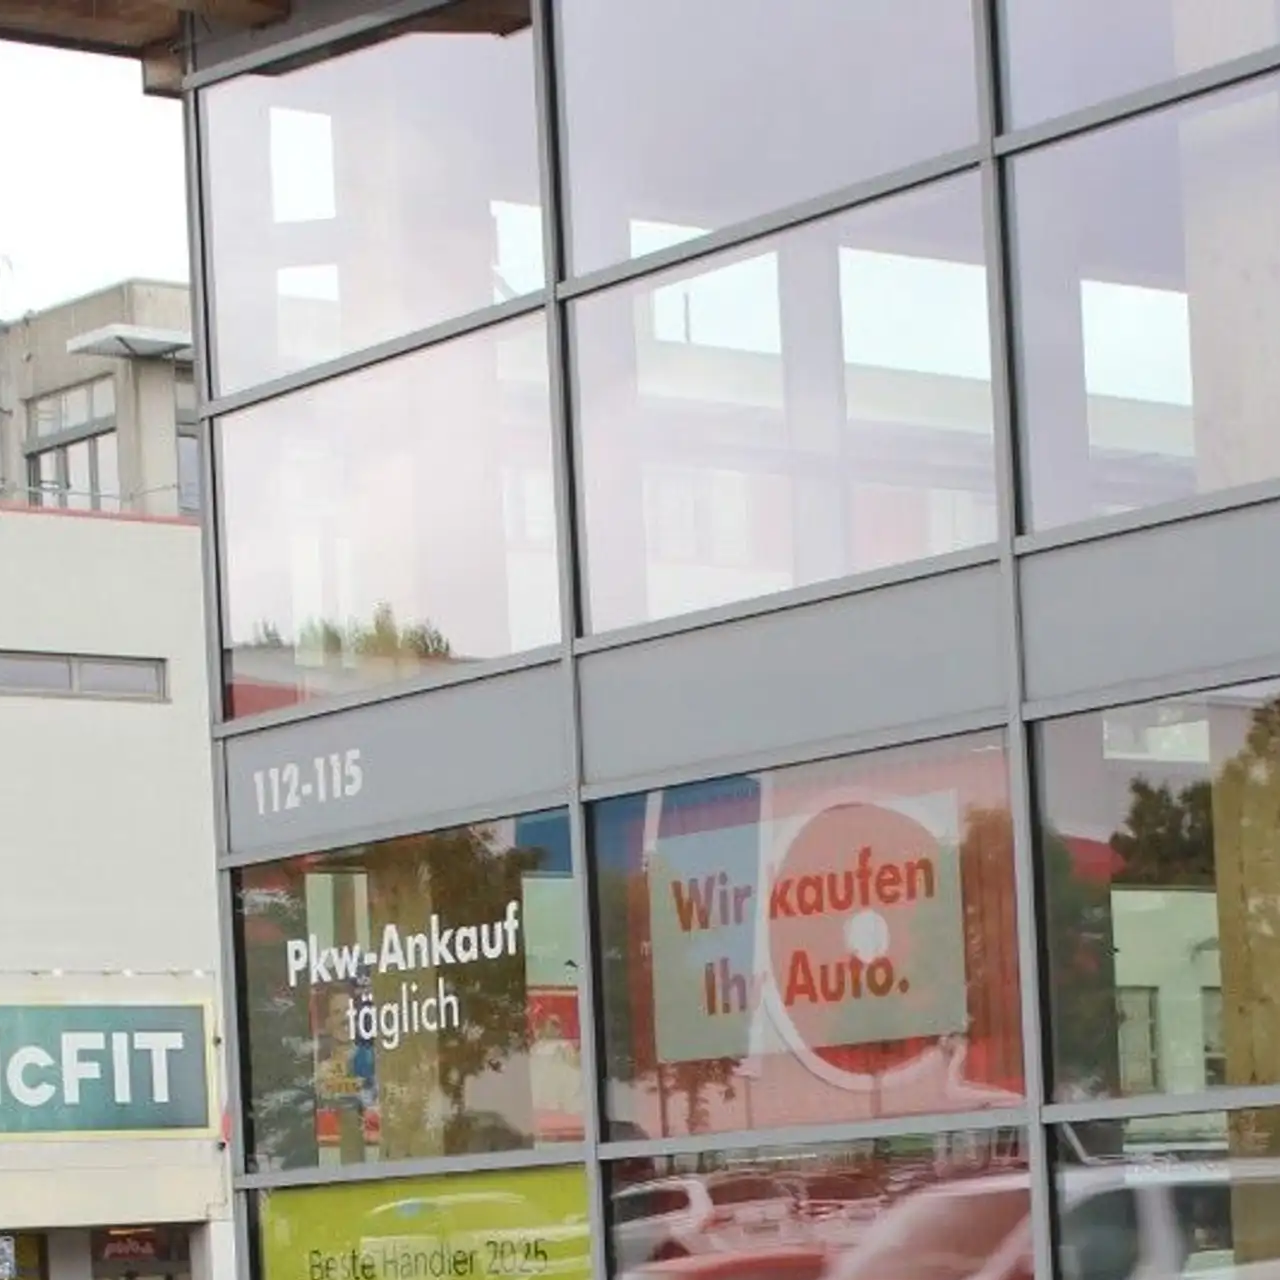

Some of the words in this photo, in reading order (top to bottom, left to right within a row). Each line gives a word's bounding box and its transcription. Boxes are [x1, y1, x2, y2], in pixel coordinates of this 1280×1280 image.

[253, 748, 363, 815] 112-115
[671, 871, 752, 932] Wir
[770, 847, 935, 919] kaufen
[286, 900, 520, 988] Pkw-Ankauf
[783, 950, 910, 1007] Auto.
[346, 977, 460, 1050] täglich
[484, 1238, 549, 1275] 2025
